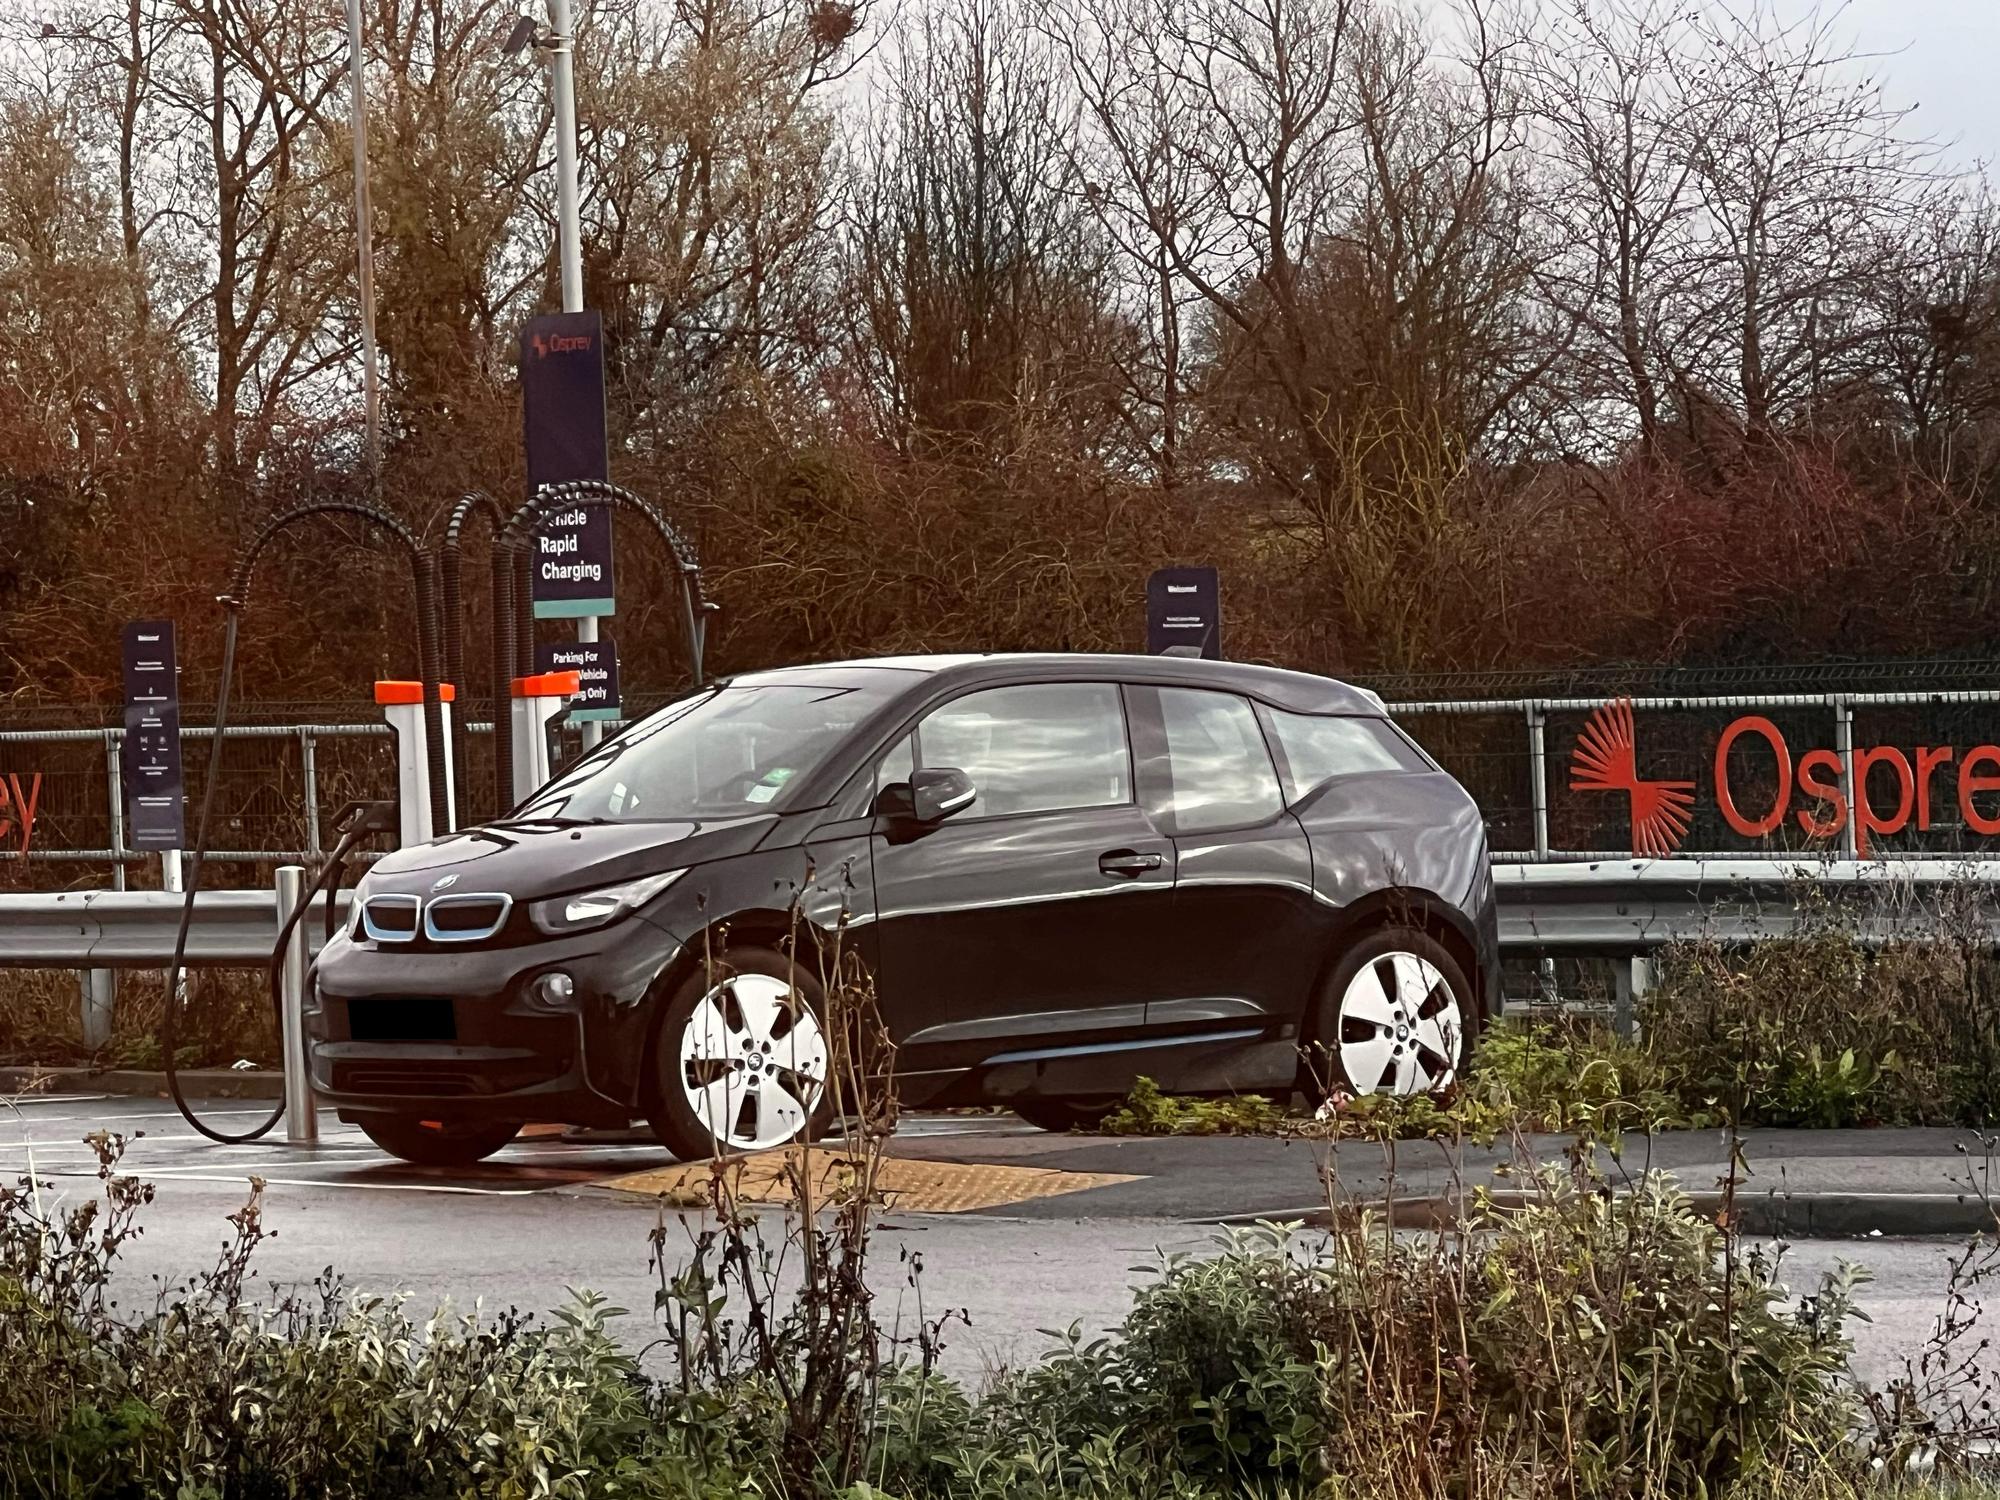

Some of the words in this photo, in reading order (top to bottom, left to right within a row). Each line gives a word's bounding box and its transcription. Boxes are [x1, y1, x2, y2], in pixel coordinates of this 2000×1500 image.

[550, 334, 592, 354] Osprey
[538, 509, 587, 527] hicle
[540, 534, 578, 557] Rapid
[541, 560, 602, 582] Charging
[553, 651, 584, 665] Parking
[585, 650, 598, 662] For
[587, 686, 607, 700] Only
